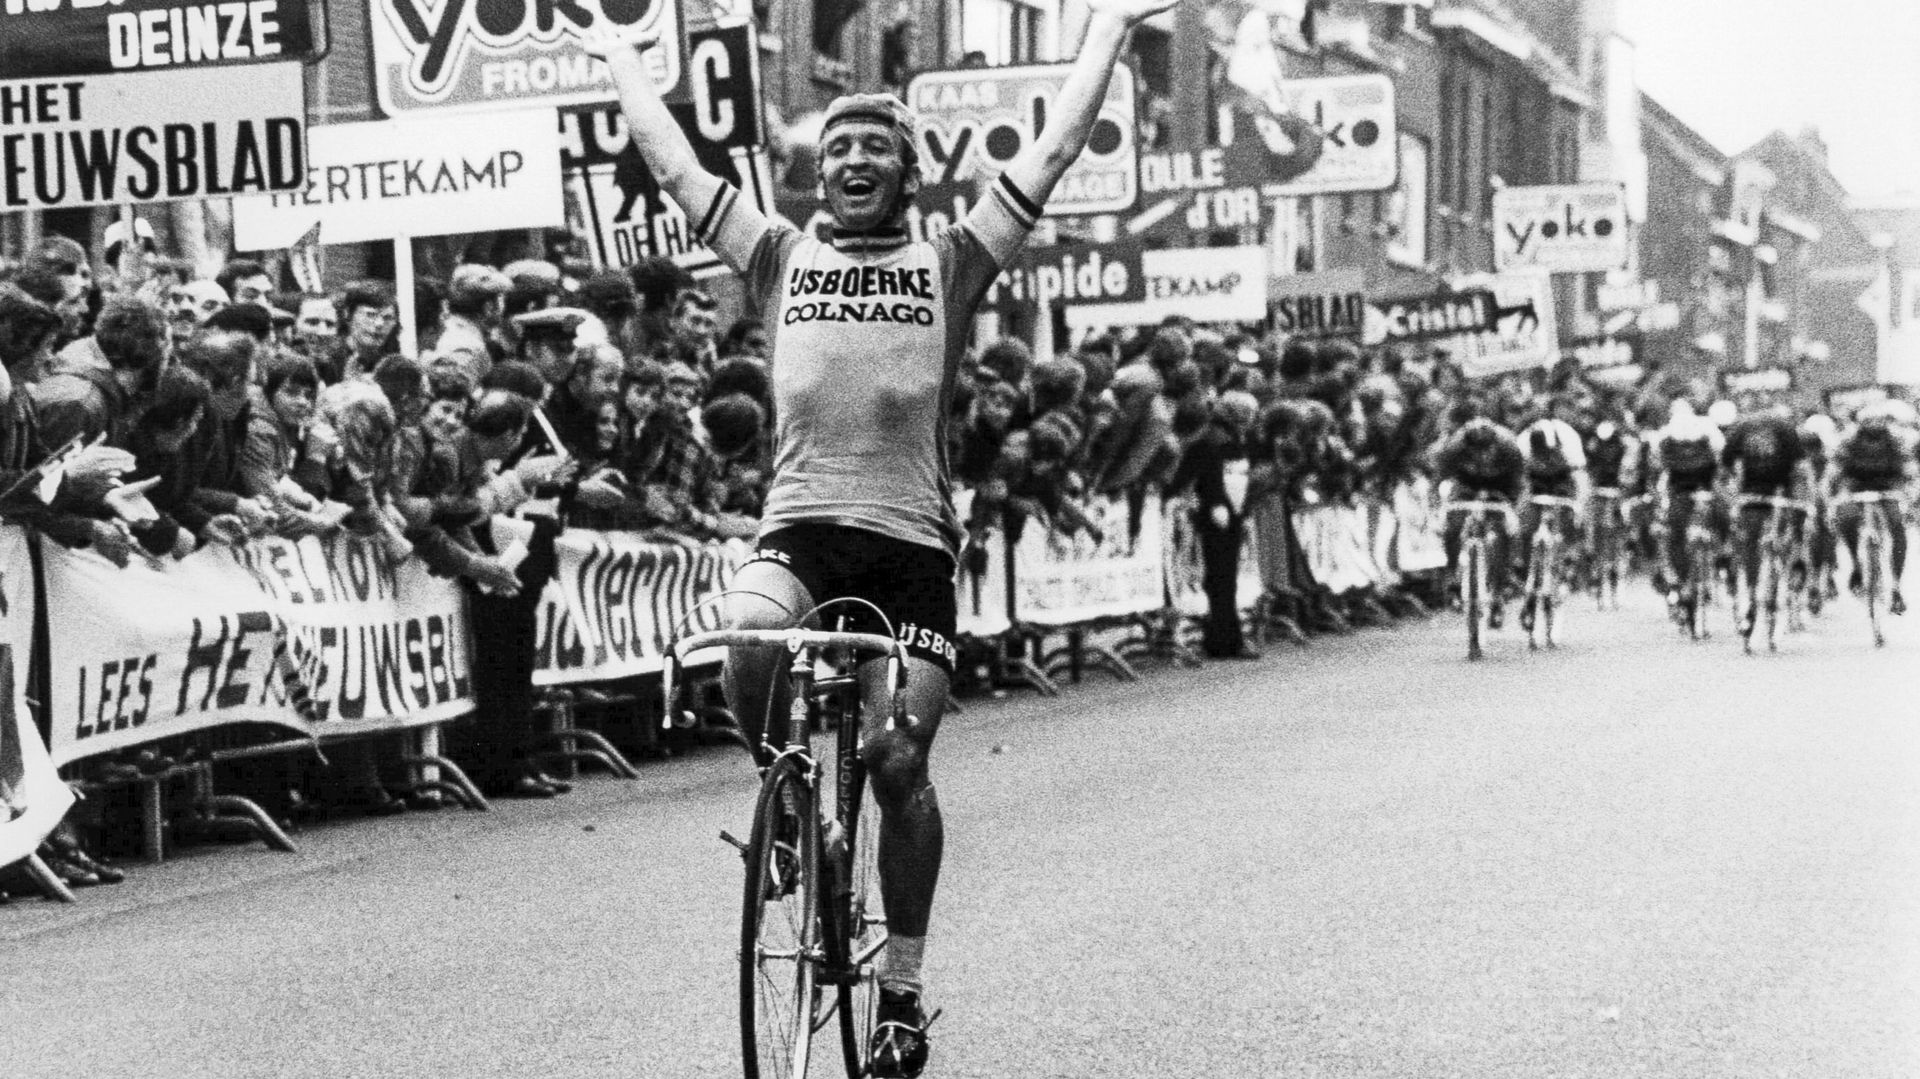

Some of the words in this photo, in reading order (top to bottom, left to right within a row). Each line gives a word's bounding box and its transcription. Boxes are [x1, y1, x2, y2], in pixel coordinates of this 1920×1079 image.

[107, 0, 282, 68] DEINZE
[481, 43, 667, 96] FROMAE
[1, 81, 86, 125] HET
[3, 116, 303, 207] EUWSBLAD
[272, 150, 523, 207] ERTEKAMP
[1506, 202, 1614, 255] yoko
[784, 301, 935, 326] COLNAGO
[76, 652, 158, 740] LEES
